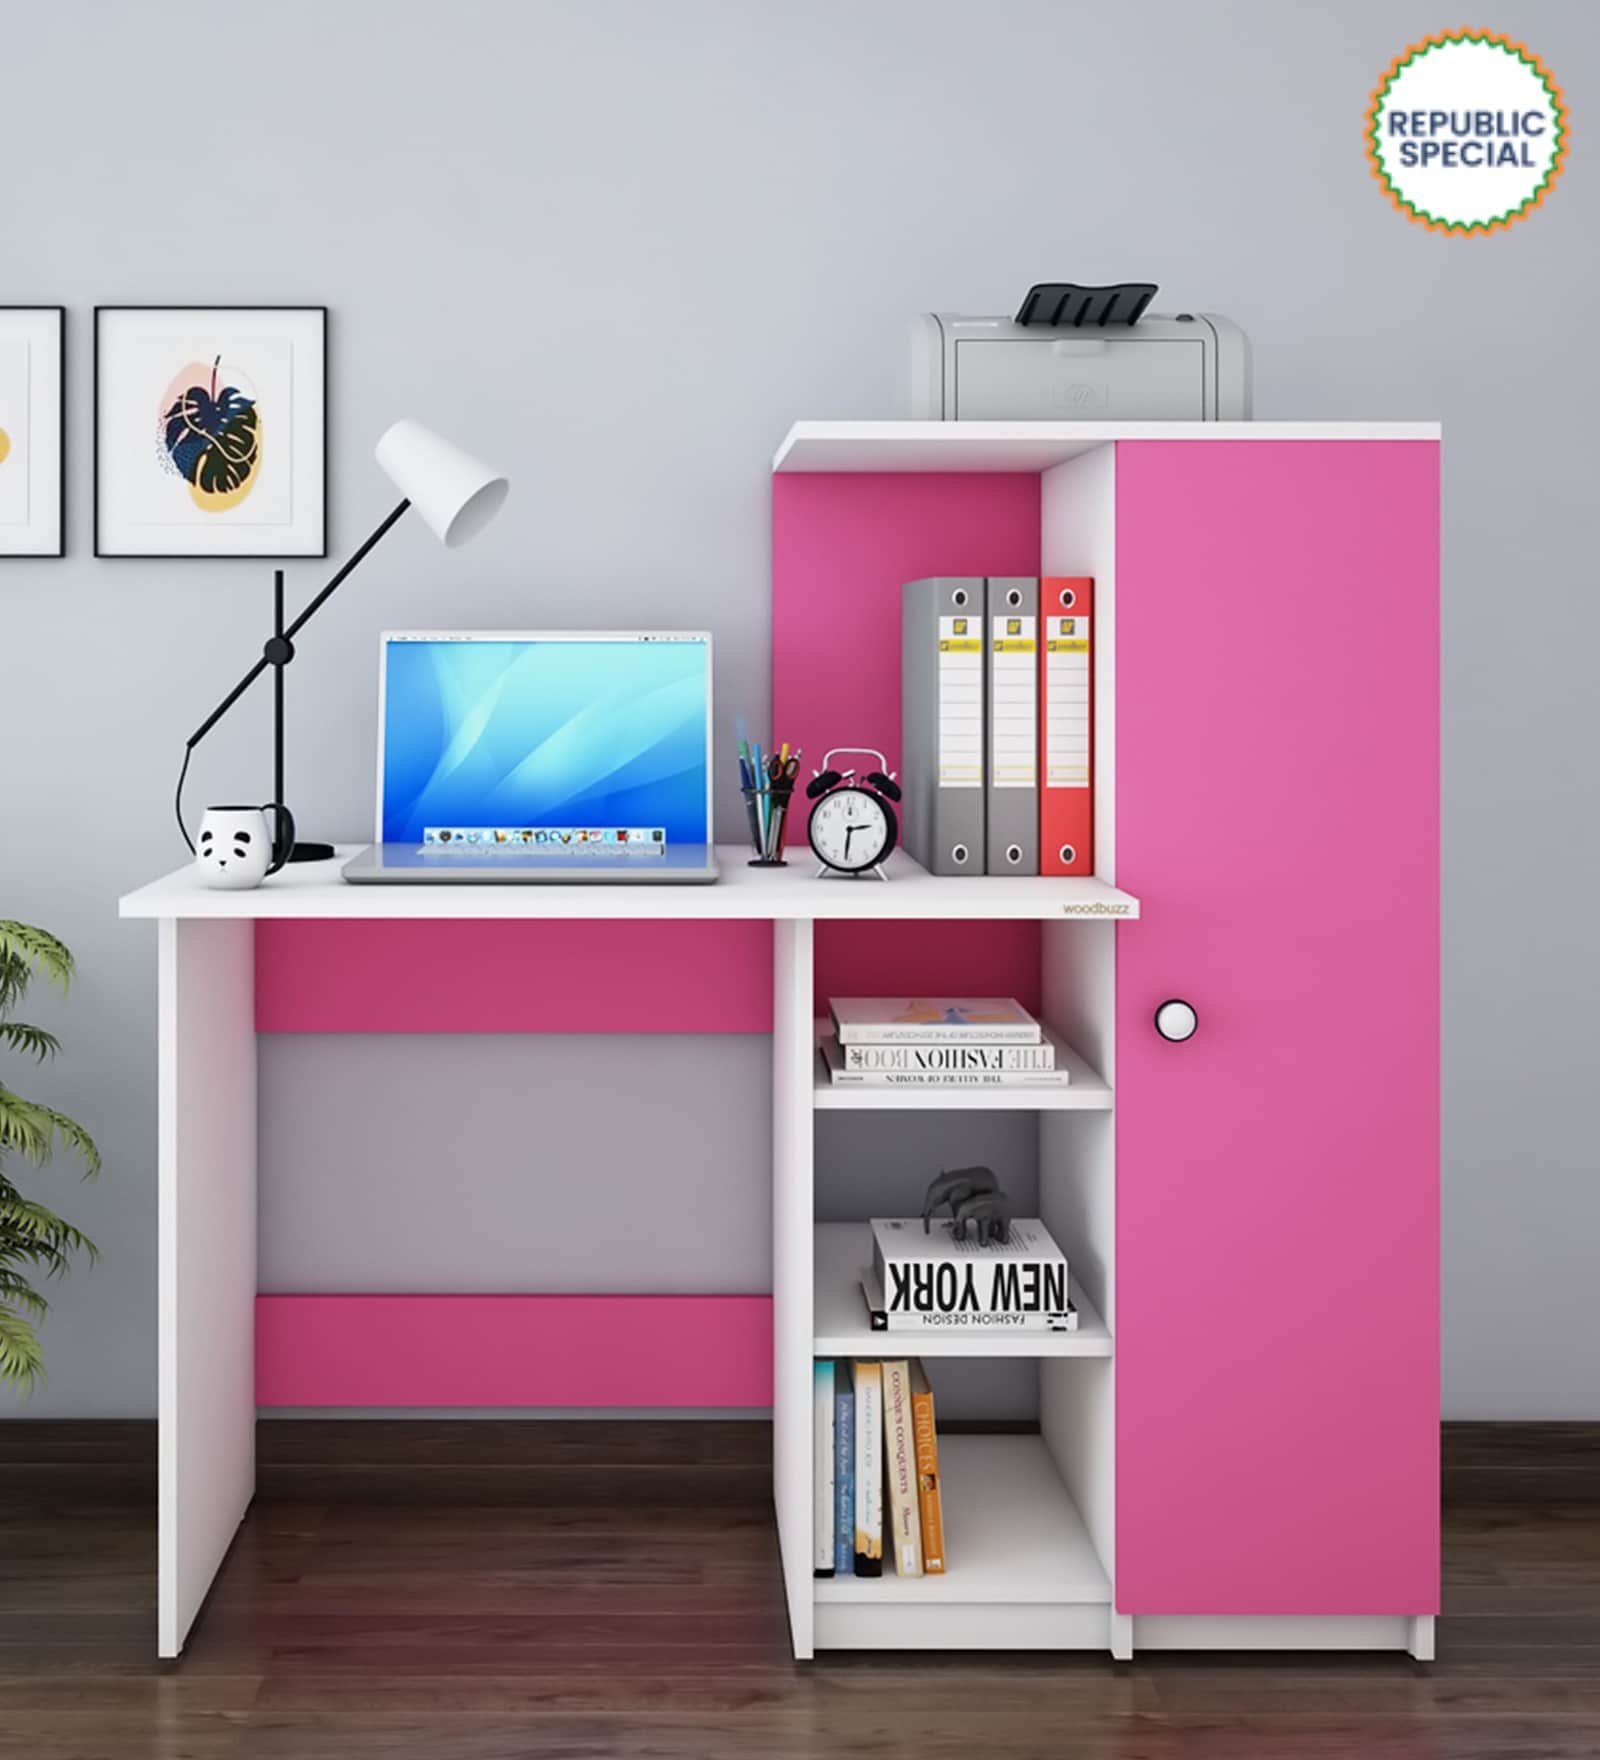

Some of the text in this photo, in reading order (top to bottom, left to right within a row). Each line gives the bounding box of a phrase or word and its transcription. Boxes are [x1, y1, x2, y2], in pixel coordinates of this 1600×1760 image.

[1063, 902, 1129, 914] woodbuzz
[914, 1049, 1004, 1069] FASHION
[1008, 1049, 1052, 1069] THE
[889, 1262, 1065, 1312] NEW YORK
[923, 1314, 1025, 1325] FASHION DESIGN
[915, 1401, 934, 1472] CHOICES
